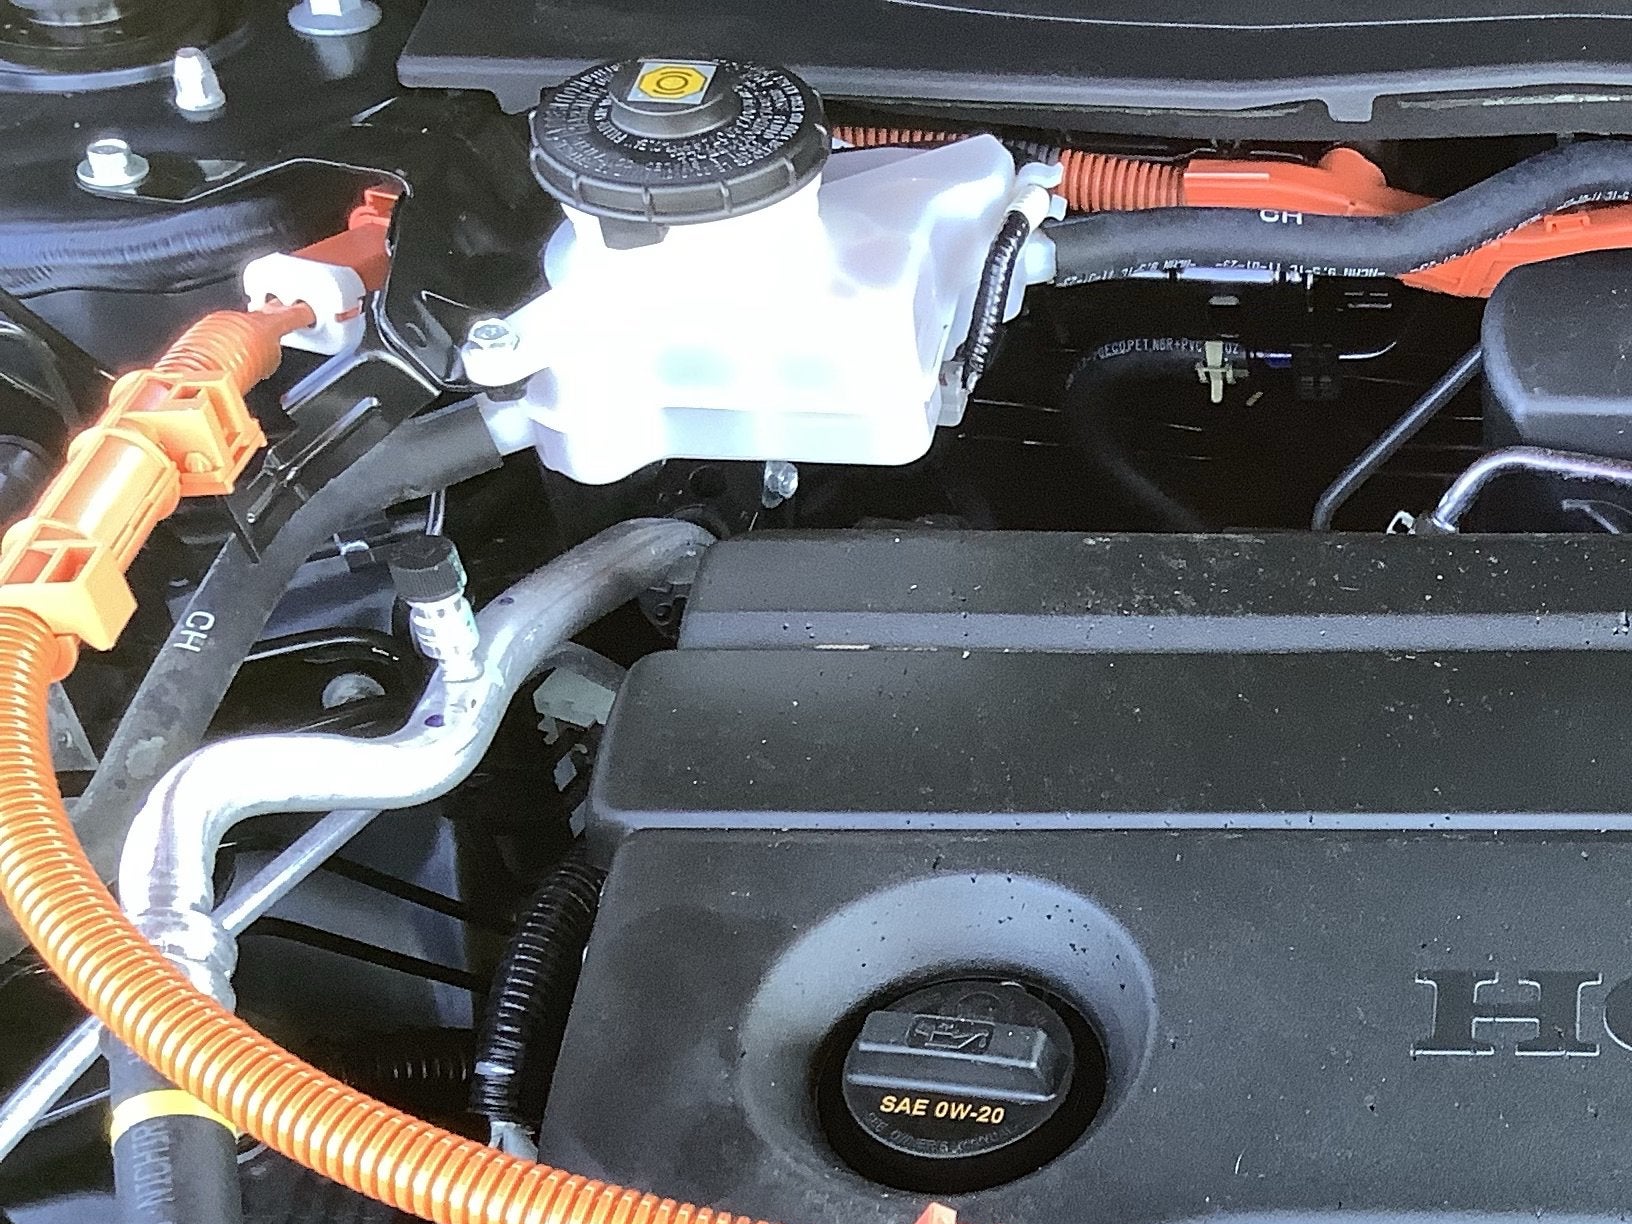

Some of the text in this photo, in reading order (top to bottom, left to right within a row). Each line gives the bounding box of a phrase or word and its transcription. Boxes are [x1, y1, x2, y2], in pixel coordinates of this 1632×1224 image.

[173, 610, 215, 653] CH
[879, 1095, 1005, 1124] SAE 0W-20
